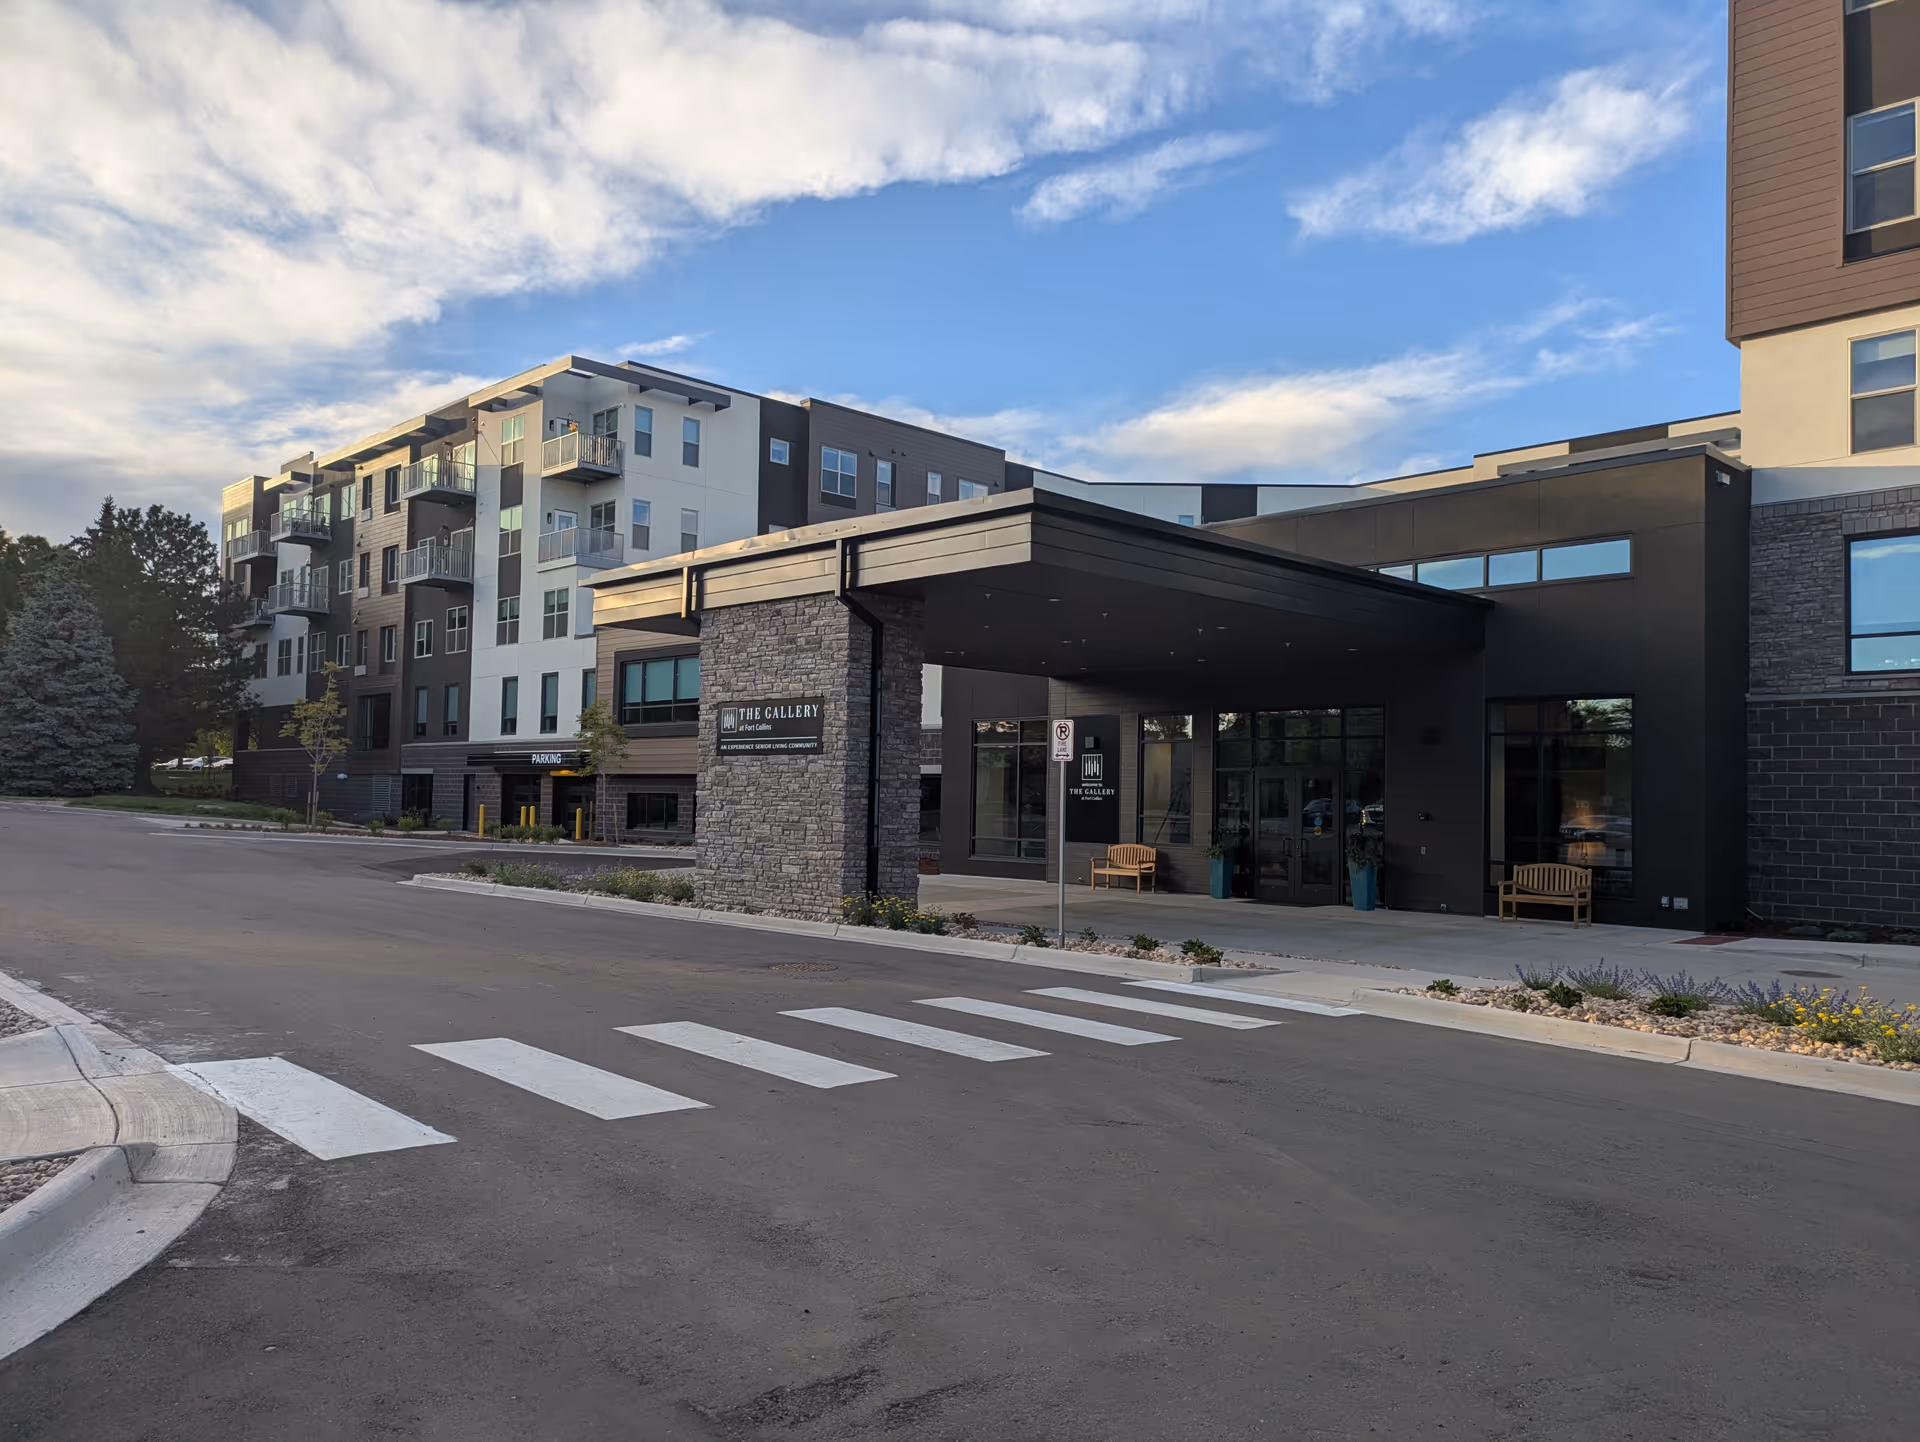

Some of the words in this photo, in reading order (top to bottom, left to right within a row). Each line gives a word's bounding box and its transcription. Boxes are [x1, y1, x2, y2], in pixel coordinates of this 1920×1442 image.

[739, 707, 761, 720] THE
[765, 704, 819, 719] GALLERY
[745, 723, 755, 732] Fort
[756, 723, 772, 731] Collins
[531, 753, 561, 764] PARKING
